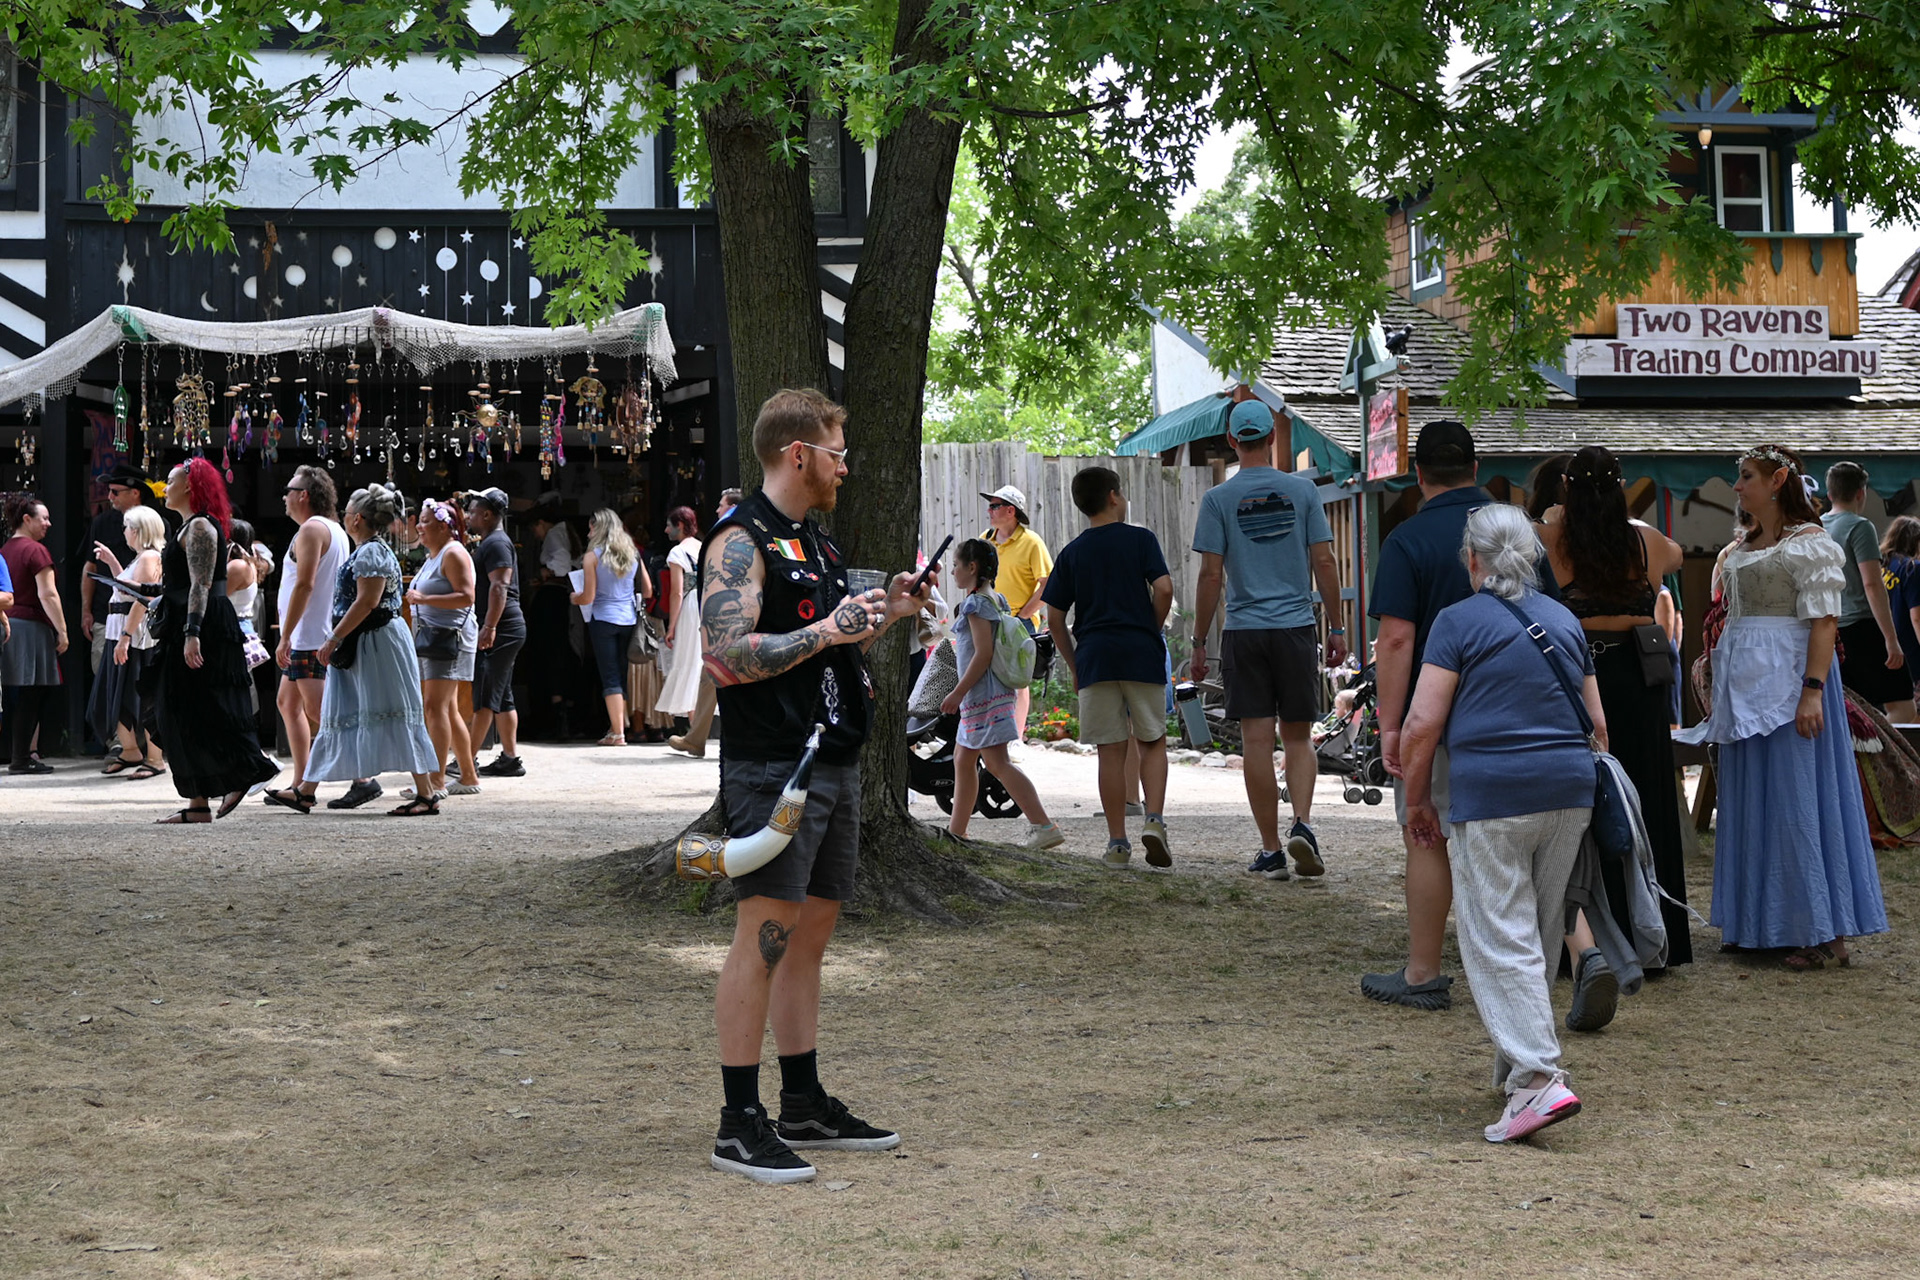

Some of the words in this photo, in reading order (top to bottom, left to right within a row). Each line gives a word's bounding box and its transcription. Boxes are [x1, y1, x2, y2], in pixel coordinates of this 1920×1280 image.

[1624, 307, 1691, 337] Two
[1700, 308, 1823, 337] Ravens
[1606, 342, 1721, 375] Trading
[1730, 343, 1877, 375] Company
